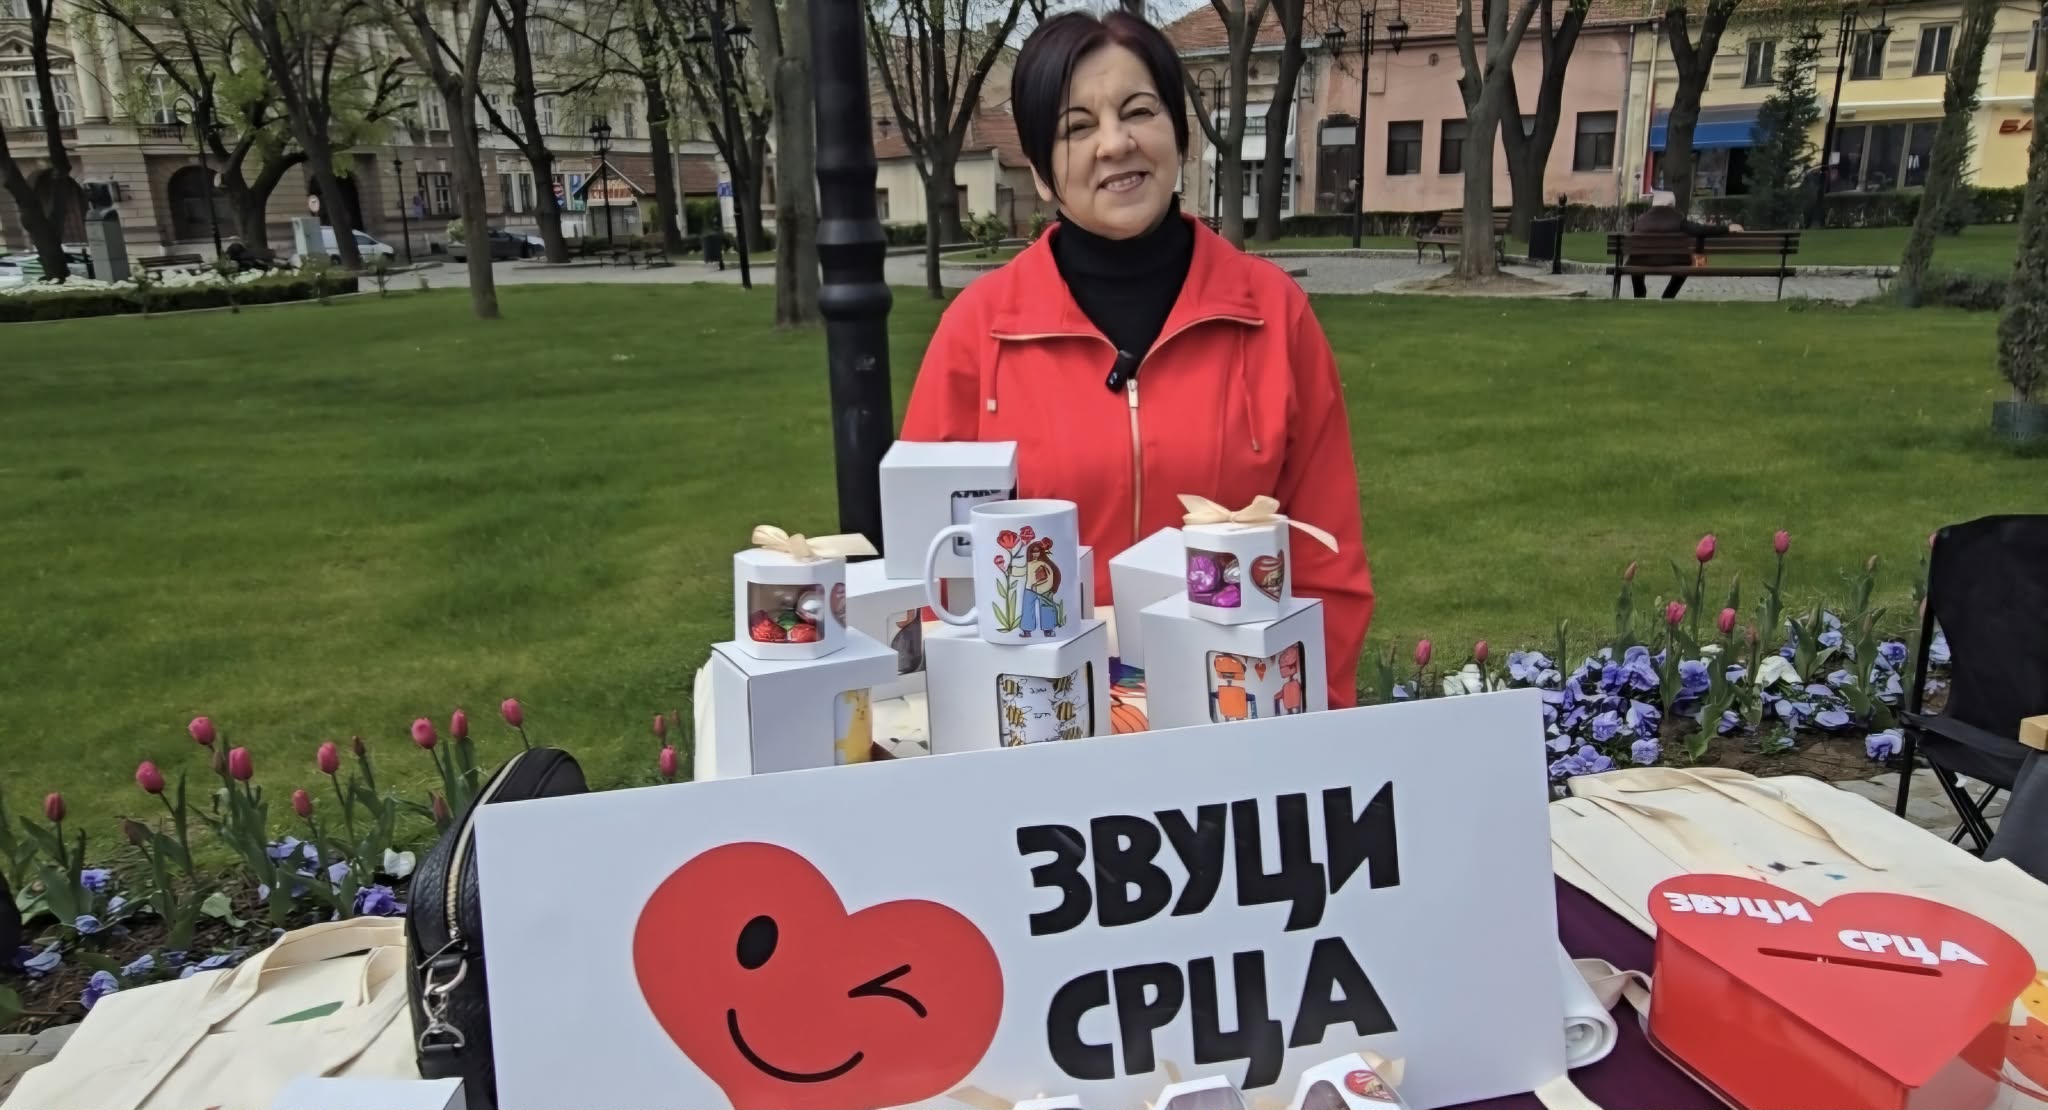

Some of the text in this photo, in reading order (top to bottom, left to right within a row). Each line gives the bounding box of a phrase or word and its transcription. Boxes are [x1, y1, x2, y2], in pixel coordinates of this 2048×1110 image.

[1016, 781, 1400, 936] ЗВУЦИ
[1663, 892, 1989, 966] ЗВУЦИ СРЦА
[1047, 936, 1398, 1090] СРЦА
